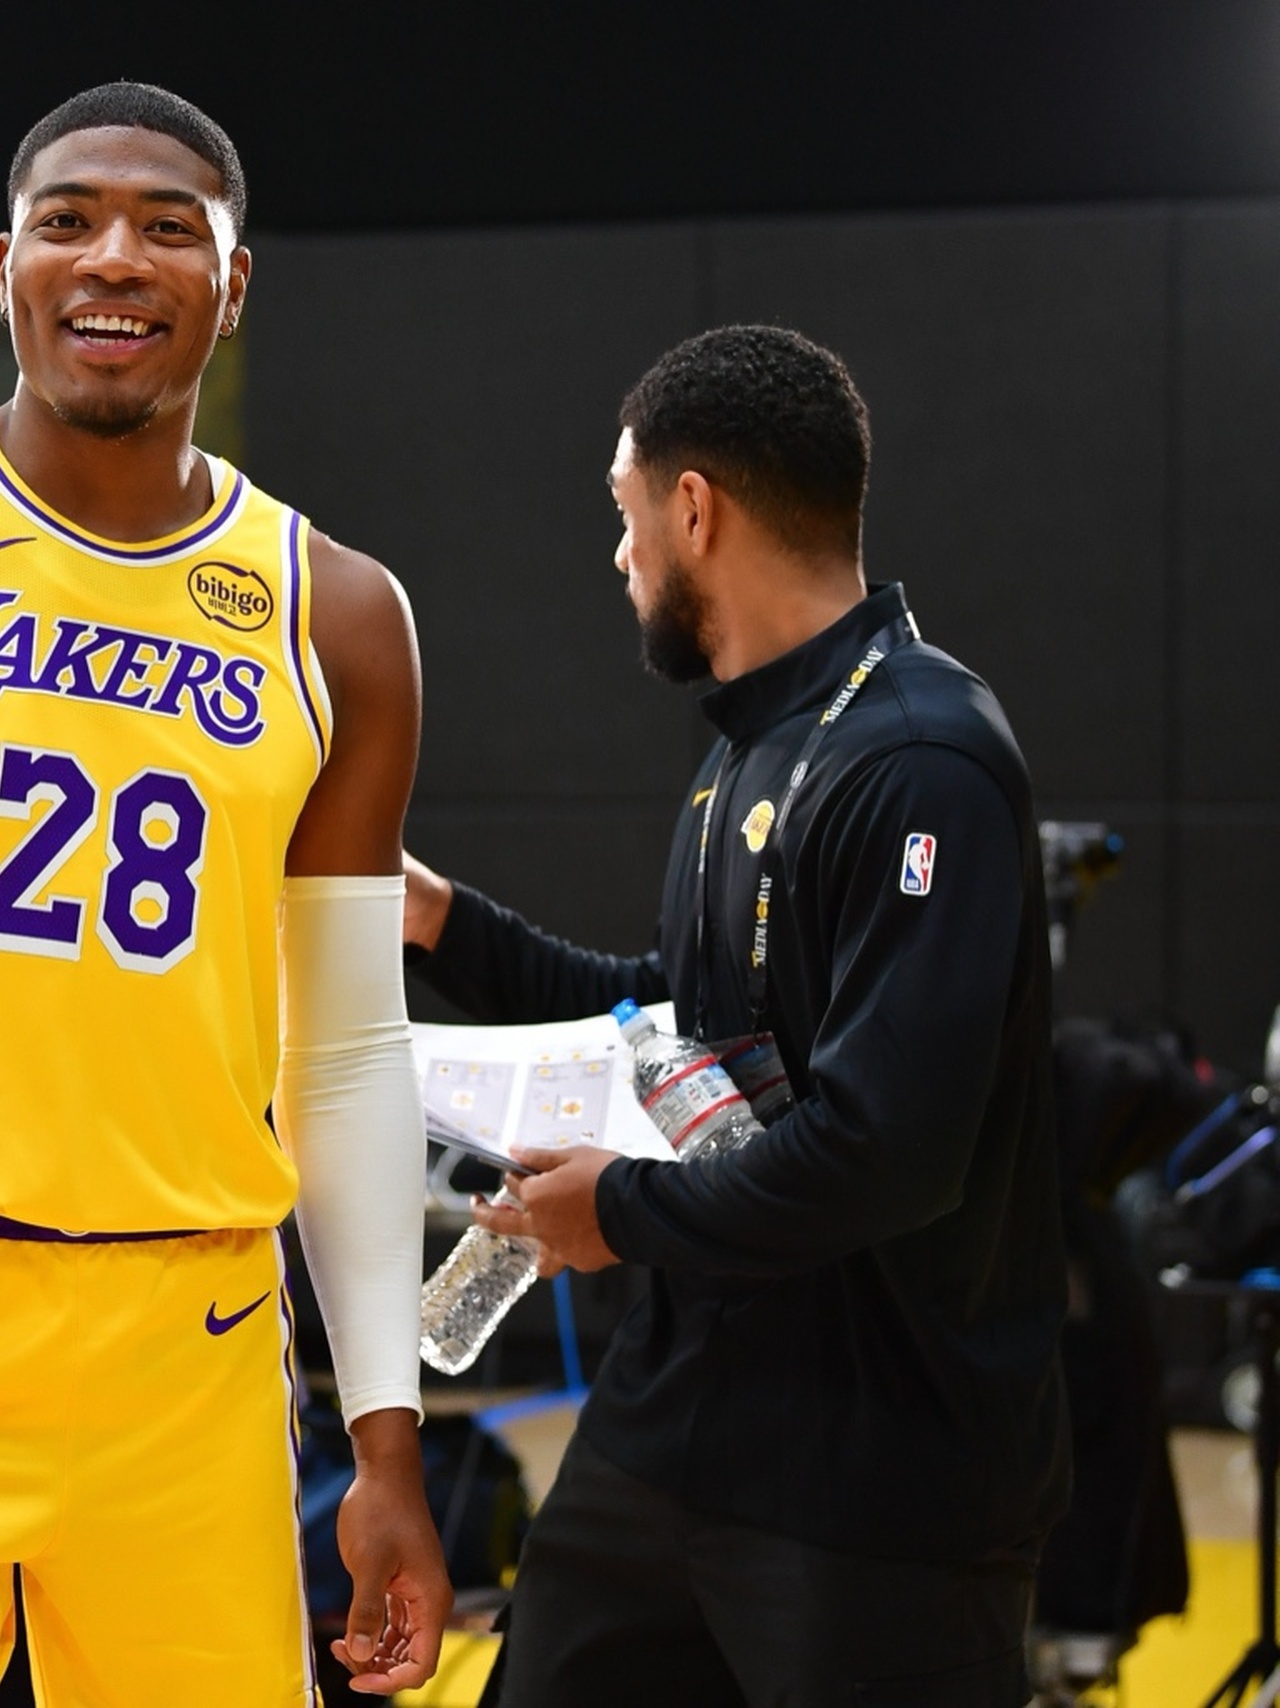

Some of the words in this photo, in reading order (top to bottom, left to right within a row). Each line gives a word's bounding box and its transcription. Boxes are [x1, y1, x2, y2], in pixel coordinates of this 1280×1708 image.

[196, 573, 268, 616] bibigo
[825, 684, 860, 723] MEDIA
[857, 646, 885, 672] DAY
[757, 872, 772, 902] DAY
[754, 918, 767, 966] MEDIA
